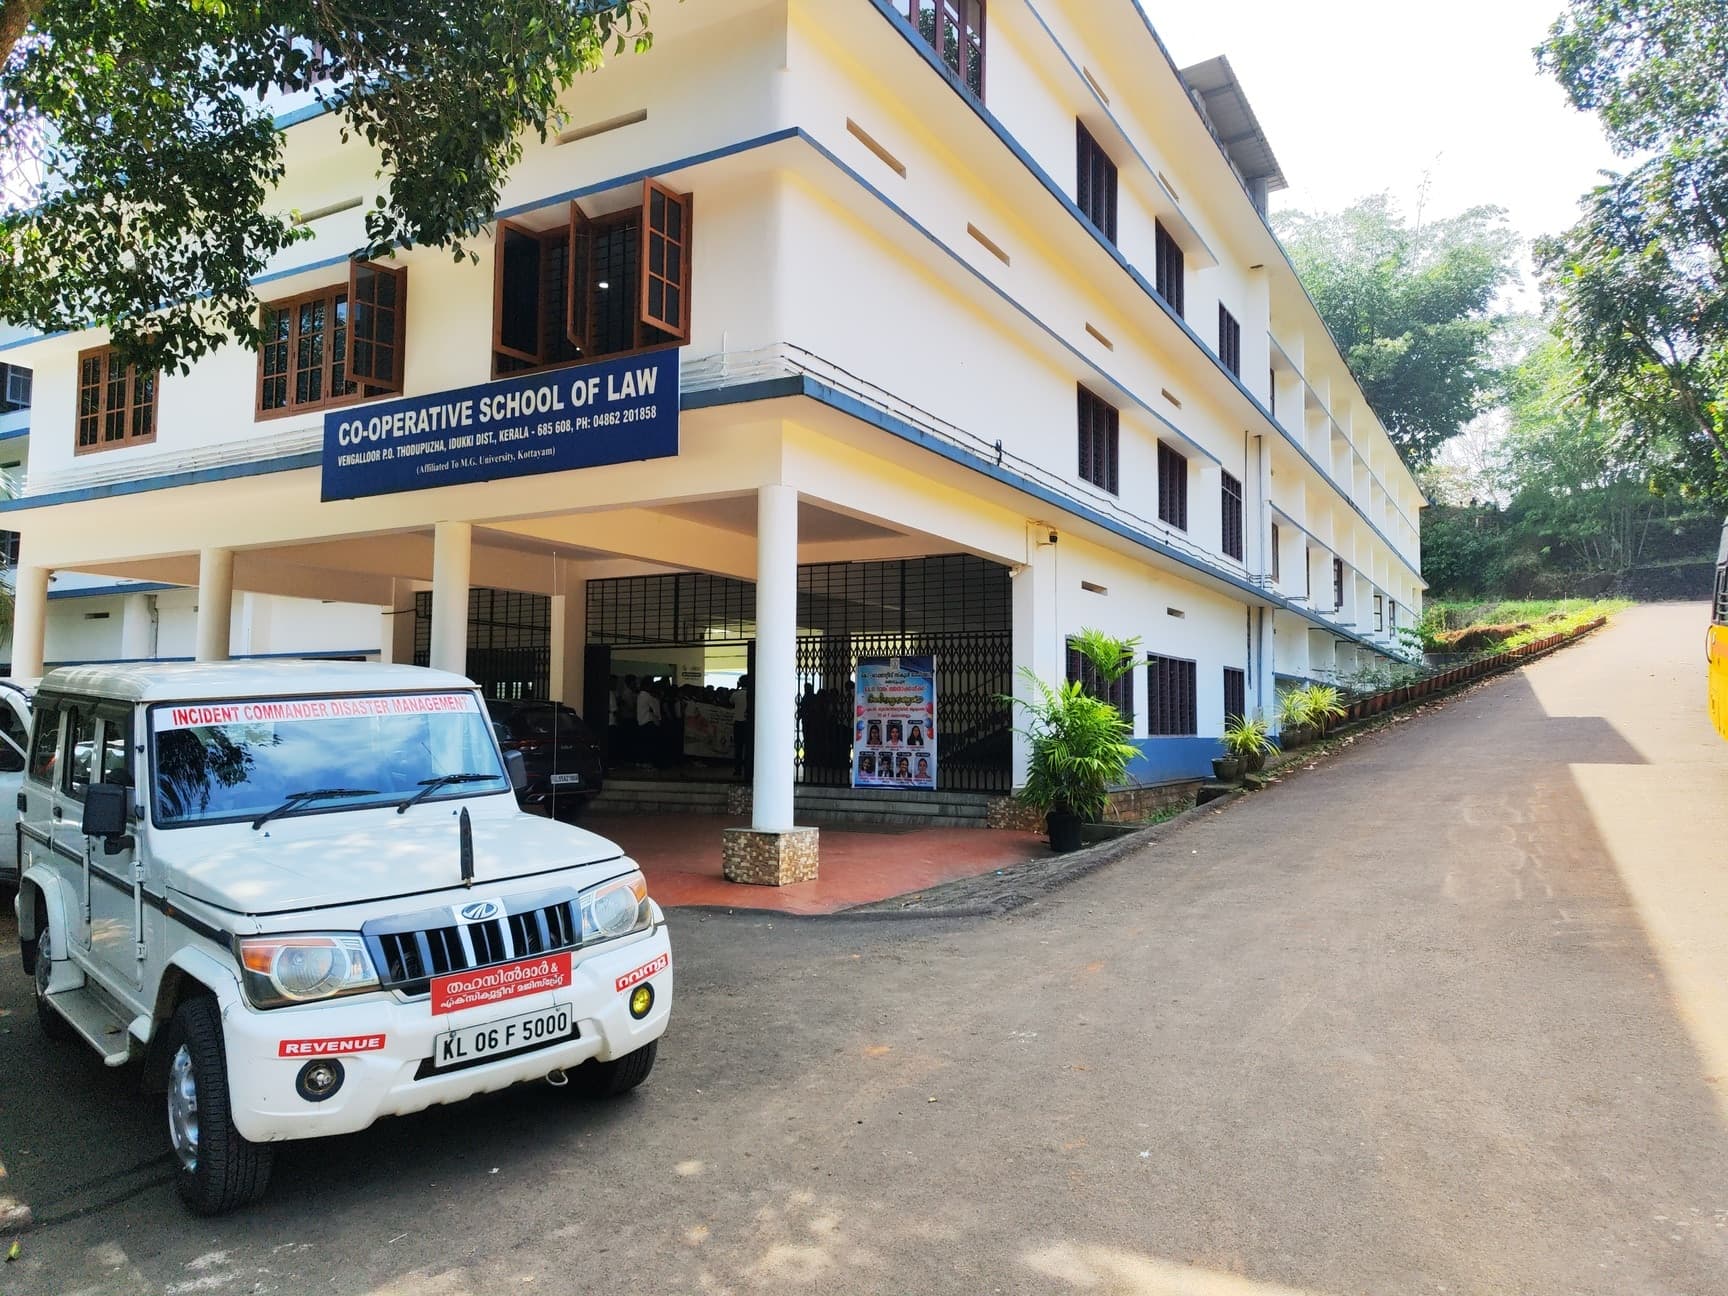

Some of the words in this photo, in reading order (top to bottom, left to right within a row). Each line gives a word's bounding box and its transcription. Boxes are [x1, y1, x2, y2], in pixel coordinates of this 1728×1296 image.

[338, 400, 473, 446] CO-OPERATIVE
[480, 384, 565, 424] SCHOOL
[571, 377, 600, 407] OF
[607, 366, 658, 401] LAW
[338, 450, 380, 467] VENGALLOOR
[382, 448, 395, 460] P.O.
[397, 438, 447, 458] THODUPUZHA,
[449, 434, 474, 450] IDUKKI
[476, 431, 497, 447] DIST.,
[499, 426, 529, 442] KERALA
[537, 421, 552, 437] 685
[555, 418, 573, 434] 608,
[576, 415, 591, 431] PH:
[593, 410, 620, 428] 04862
[623, 404, 657, 423] 201858
[416, 460, 449, 475] (Affiliated
[451, 459, 459, 470] To
[461, 456, 477, 468] M.G.
[480, 452, 516, 466] University,
[517, 446, 556, 460] Kottayam)
[172, 706, 240, 726] INCIDENT
[244, 700, 329, 721] COMMANDER
[331, 699, 390, 716] DISASTER
[394, 695, 469, 712] MANAGEMENT
[551, 962, 559, 973] &
[285, 1038, 380, 1054] REVENUE
[443, 1036, 468, 1060] KL
[475, 1030, 498, 1052] 06
[505, 1024, 516, 1045] F
[522, 1012, 568, 1040] 5000
